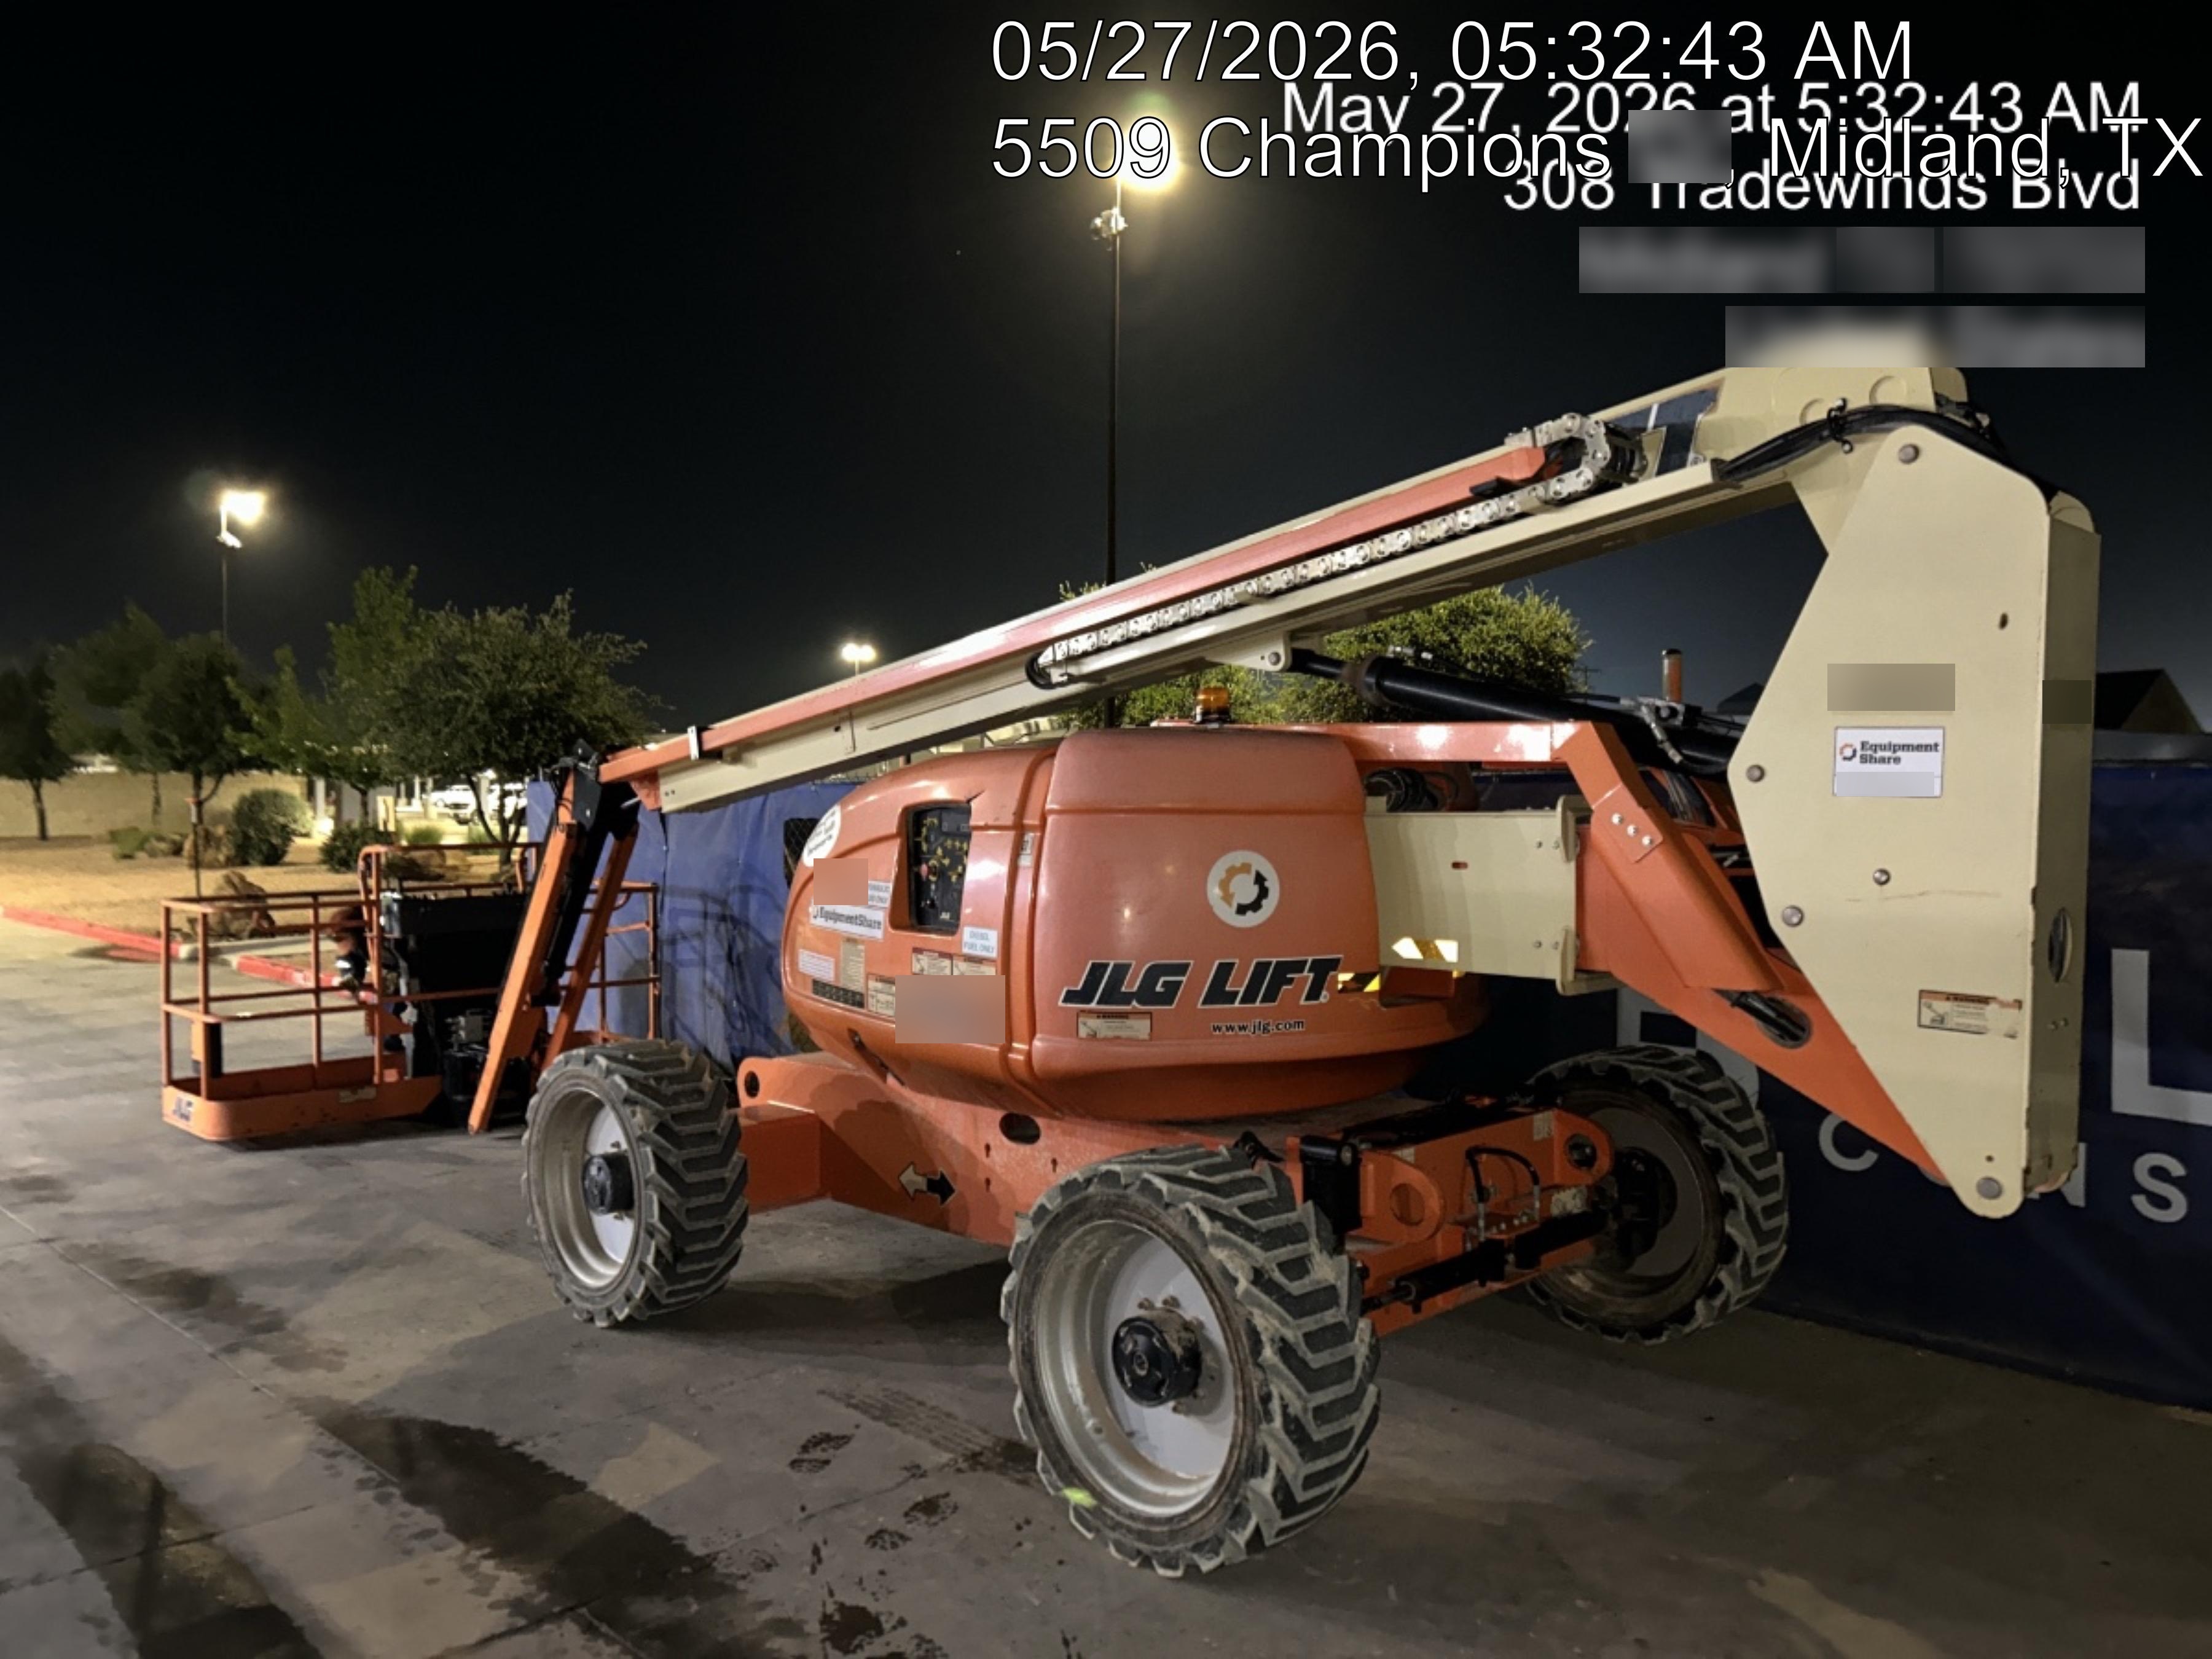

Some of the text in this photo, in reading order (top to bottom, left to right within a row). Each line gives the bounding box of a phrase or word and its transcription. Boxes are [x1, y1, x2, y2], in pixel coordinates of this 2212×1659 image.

[1860, 740, 1940, 755] Equipment
[1859, 754, 1902, 765] Share
[1059, 955, 1344, 1008] JLG LIFT
[1211, 1019, 1305, 1036] www.jlg.com
